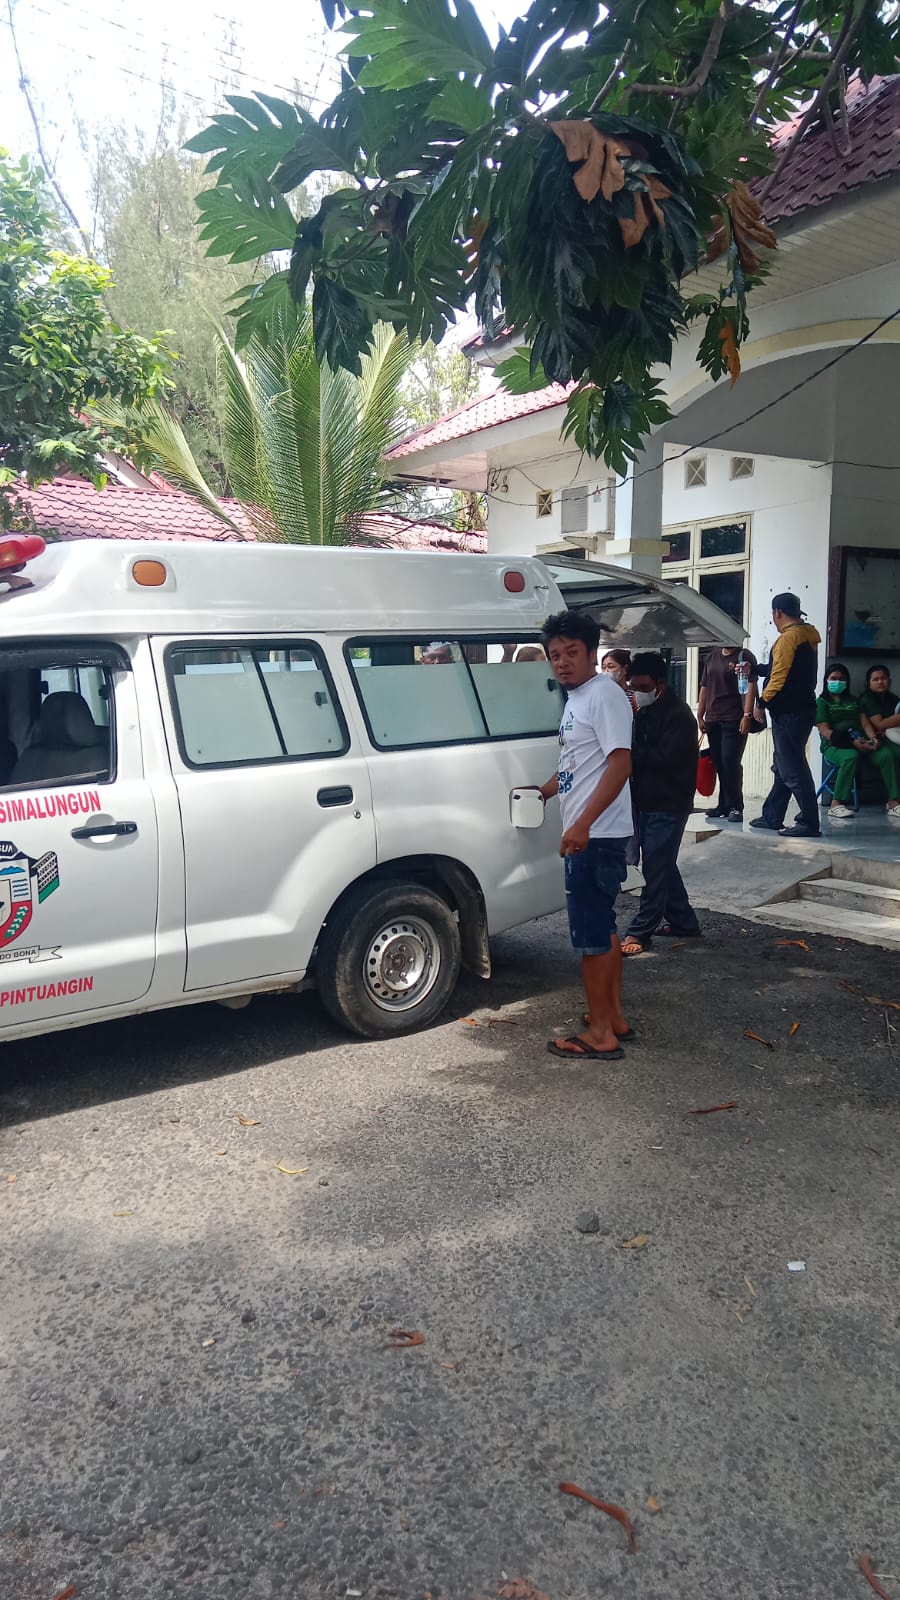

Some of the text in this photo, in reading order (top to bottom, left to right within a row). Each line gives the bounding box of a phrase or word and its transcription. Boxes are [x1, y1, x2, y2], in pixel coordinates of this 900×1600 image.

[0, 791, 101, 823] SIMALUNGUN
[13, 949, 37, 958] BONA
[0, 976, 93, 1007] PINTUANGIN
